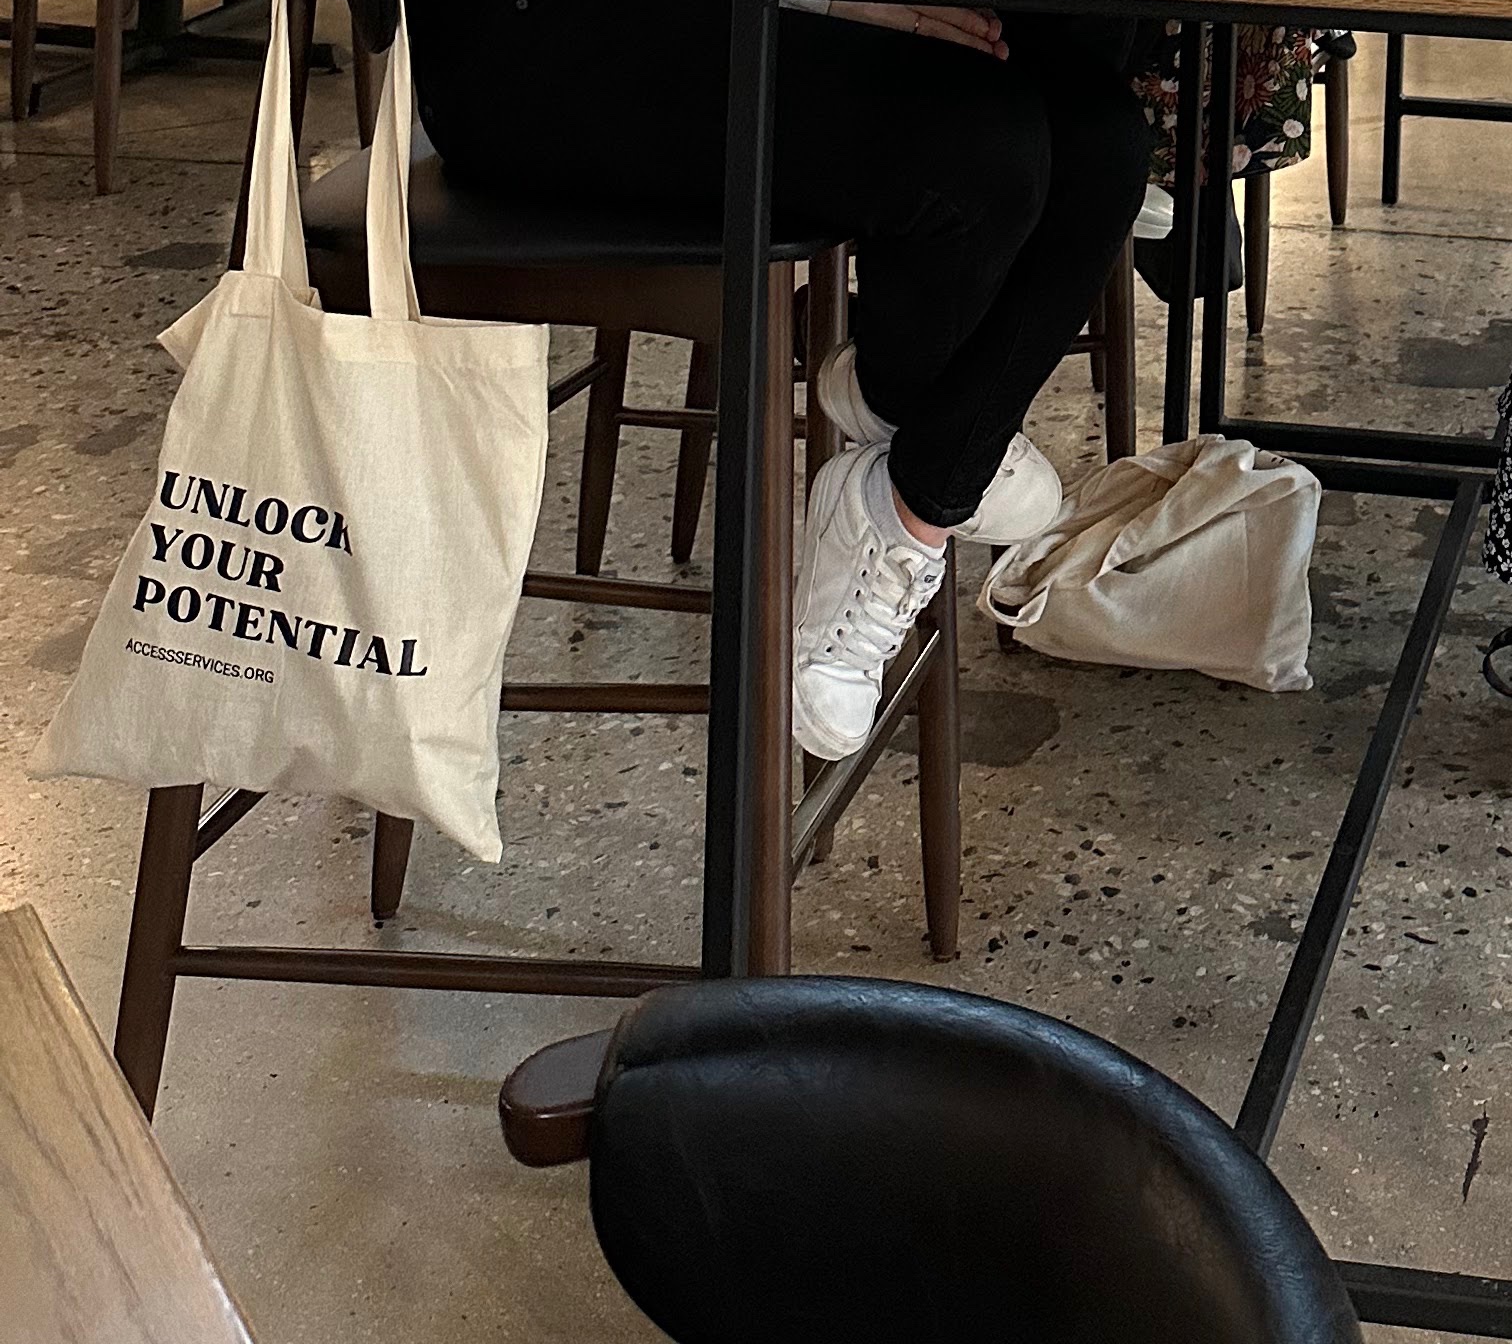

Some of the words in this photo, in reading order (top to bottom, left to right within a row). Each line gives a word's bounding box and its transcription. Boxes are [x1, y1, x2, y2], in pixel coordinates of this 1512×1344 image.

[160, 470, 353, 556] UNLOCK
[150, 522, 285, 593] YOUR
[125, 637, 275, 684] ACCESSSERVICES.ORG
[132, 574, 428, 677] POTENTIAL
